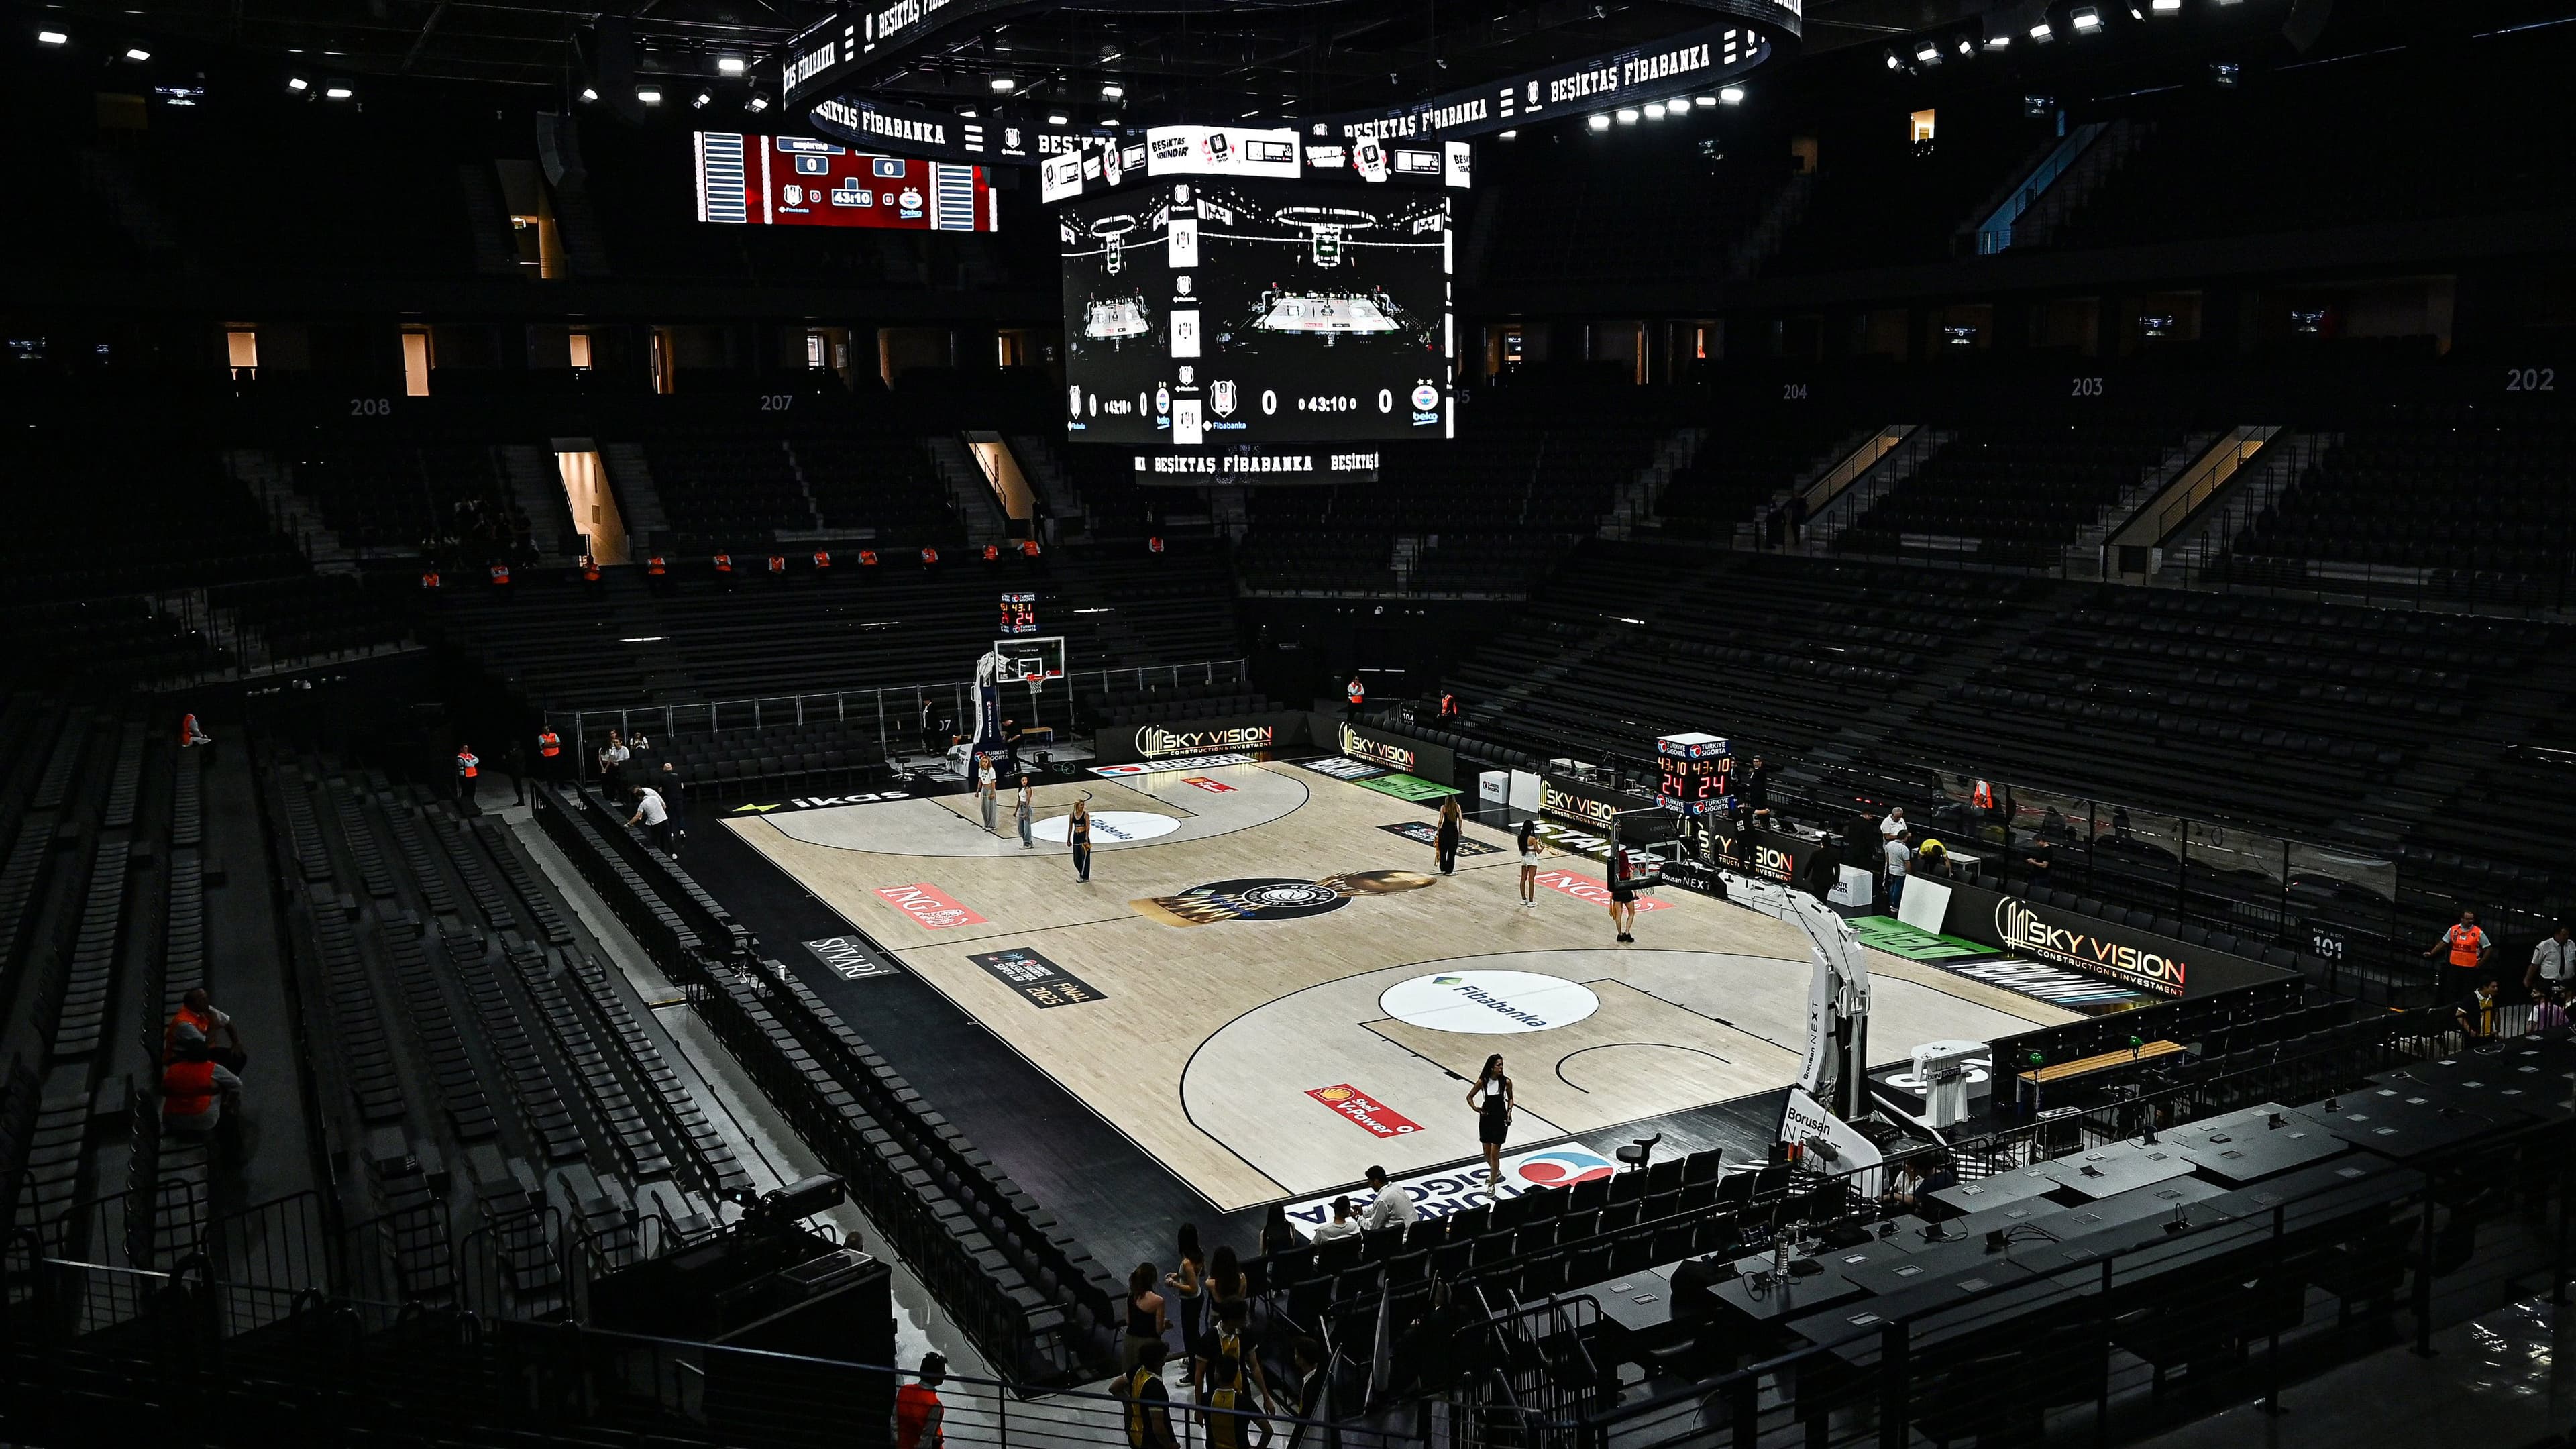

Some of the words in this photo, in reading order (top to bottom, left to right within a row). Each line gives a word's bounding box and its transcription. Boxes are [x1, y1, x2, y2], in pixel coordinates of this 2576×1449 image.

[1551, 66, 1617, 102] BEŞİKTAŞ
[1625, 44, 1710, 85] FİBABANKA
[863, 111, 945, 144] FİBABANKA
[807, 158, 816, 171] 0
[883, 162, 894, 175] 0
[834, 192, 870, 204] 43:10
[2072, 377, 2104, 396] 203
[2506, 368, 2555, 392] 202
[1378, 388, 1392, 413] 0
[1783, 383, 1808, 400] 204
[350, 398, 390, 416] 208
[761, 395, 792, 411] 207
[1262, 390, 1277, 415] 0
[1308, 396, 1347, 412] 43:10
[1213, 421, 1246, 430] Fibabanka
[1413, 411, 1438, 421] beko
[1155, 455, 1216, 474] BEŞİKTAŞ
[1224, 455, 1313, 472] FİBABANKA
[1016, 612, 1033, 625] 24
[1163, 733, 1204, 749] SKY
[1209, 726, 1271, 743] VISION
[1171, 747, 1224, 756] CONSTRUCTION
[1352, 736, 1375, 752] SKY
[1377, 743, 1414, 765] VISION
[1658, 757, 1686, 775] 43:10
[1693, 758, 1729, 775] 43:10
[1662, 774, 1682, 796] 24
[1699, 775, 1724, 798] 24
[791, 791, 910, 808] ikas
[1547, 790, 1574, 809] SKY
[1698, 830, 1731, 853] SY
[1534, 871, 1610, 896] ING
[1661, 872, 1682, 884] Borusan
[879, 885, 944, 912] ING
[2029, 921, 2085, 953] SKY
[2091, 937, 2185, 984] VISION
[2314, 936, 2342, 959] 101
[1946, 959, 2128, 998] MEDICANA
[2037, 949, 2110, 975] CONSTRUCTION
[2120, 973, 2184, 997] INVESTMENT
[1026, 987, 1065, 1005] 2025
[1053, 983, 1090, 1003] FİNAL
[1454, 985, 1547, 1028] Fibabanka
[1803, 1046, 1815, 1081] Borusan
[1811, 1000, 1819, 1044] NEXT
[1352, 1097, 1379, 1112] Shell
[1336, 1100, 1394, 1136] V-Power
[1788, 1107, 1831, 1136] Borusan
